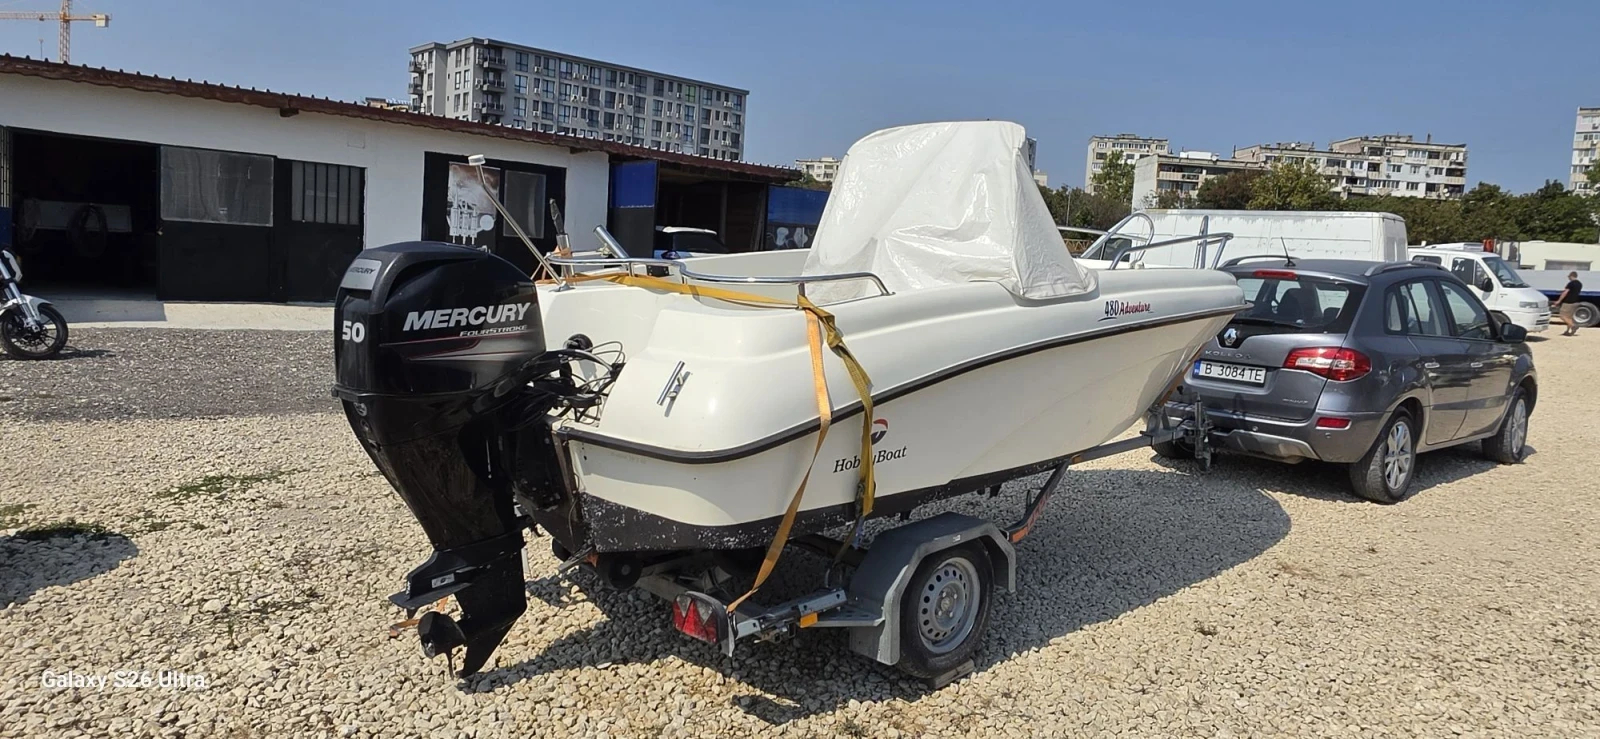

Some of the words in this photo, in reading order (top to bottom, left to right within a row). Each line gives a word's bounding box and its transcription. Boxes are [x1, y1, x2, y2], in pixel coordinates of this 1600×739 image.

[402, 302, 531, 332] MERCURY
[1104, 300, 1119, 316] 480
[1119, 301, 1151, 315] Adventure
[342, 320, 365, 343] 50
[1204, 363, 1213, 375] B
[1217, 364, 1246, 379] 3084
[833, 445, 907, 473] HobBoat
